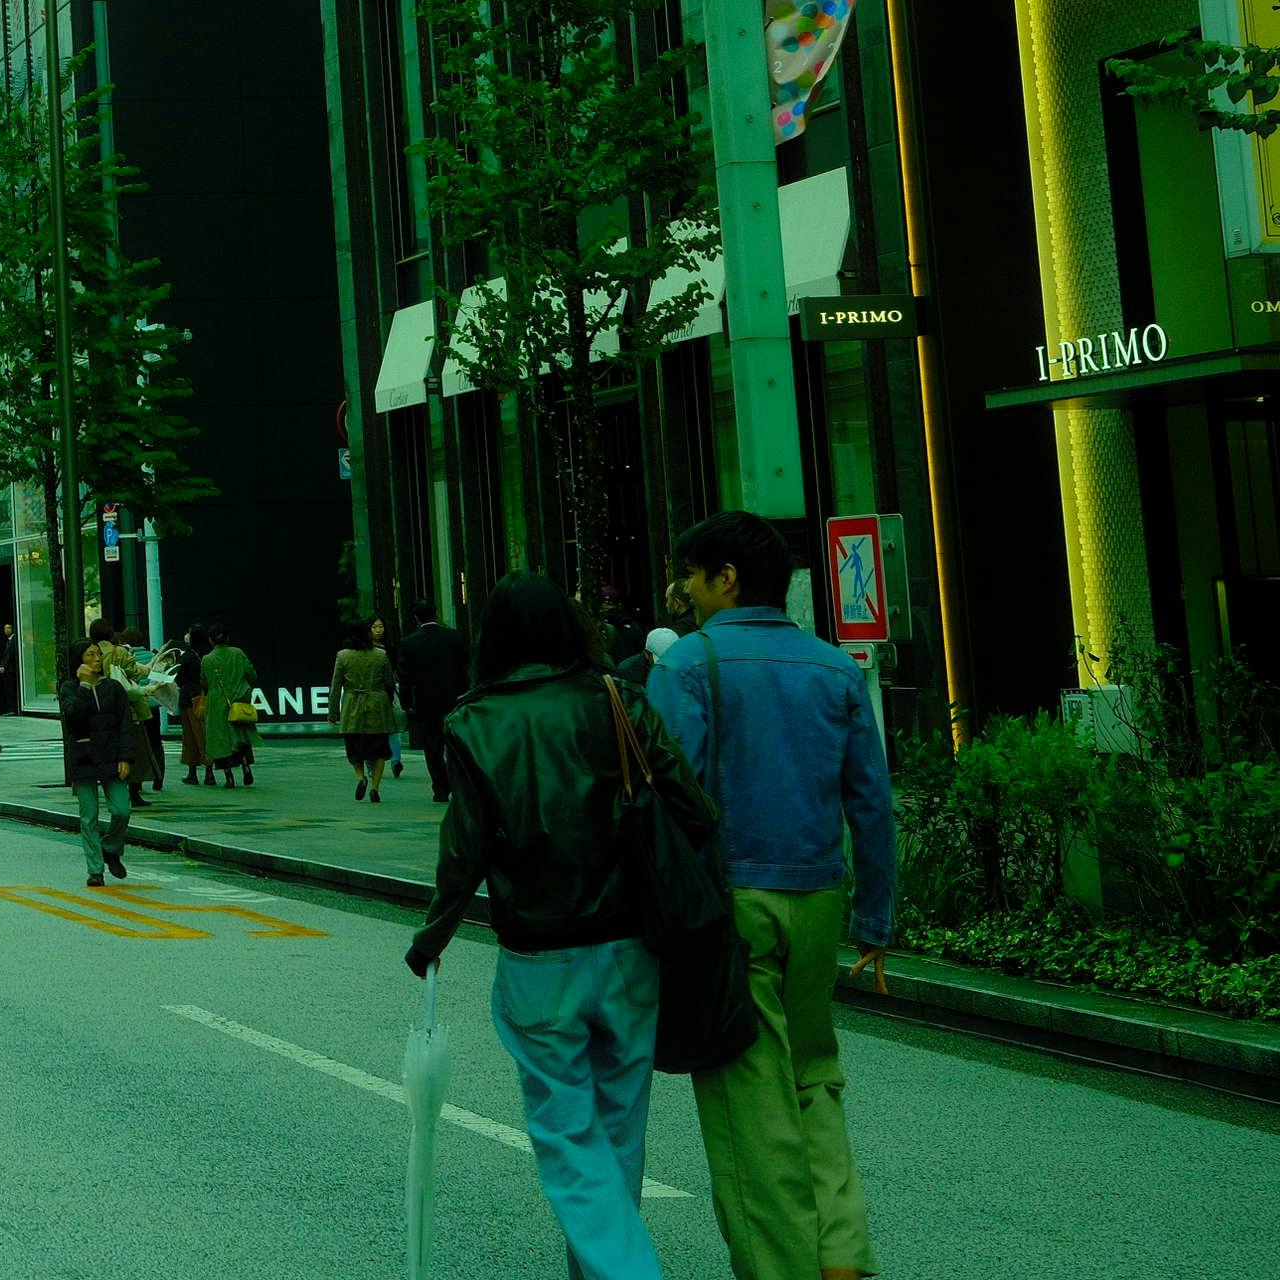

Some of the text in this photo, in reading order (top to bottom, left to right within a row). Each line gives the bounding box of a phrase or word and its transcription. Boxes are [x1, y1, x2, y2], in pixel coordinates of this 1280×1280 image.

[819, 309, 904, 326] I-PRIMO
[1035, 322, 1169, 383] I-PRIMO
[250, 686, 344, 716] ANE
